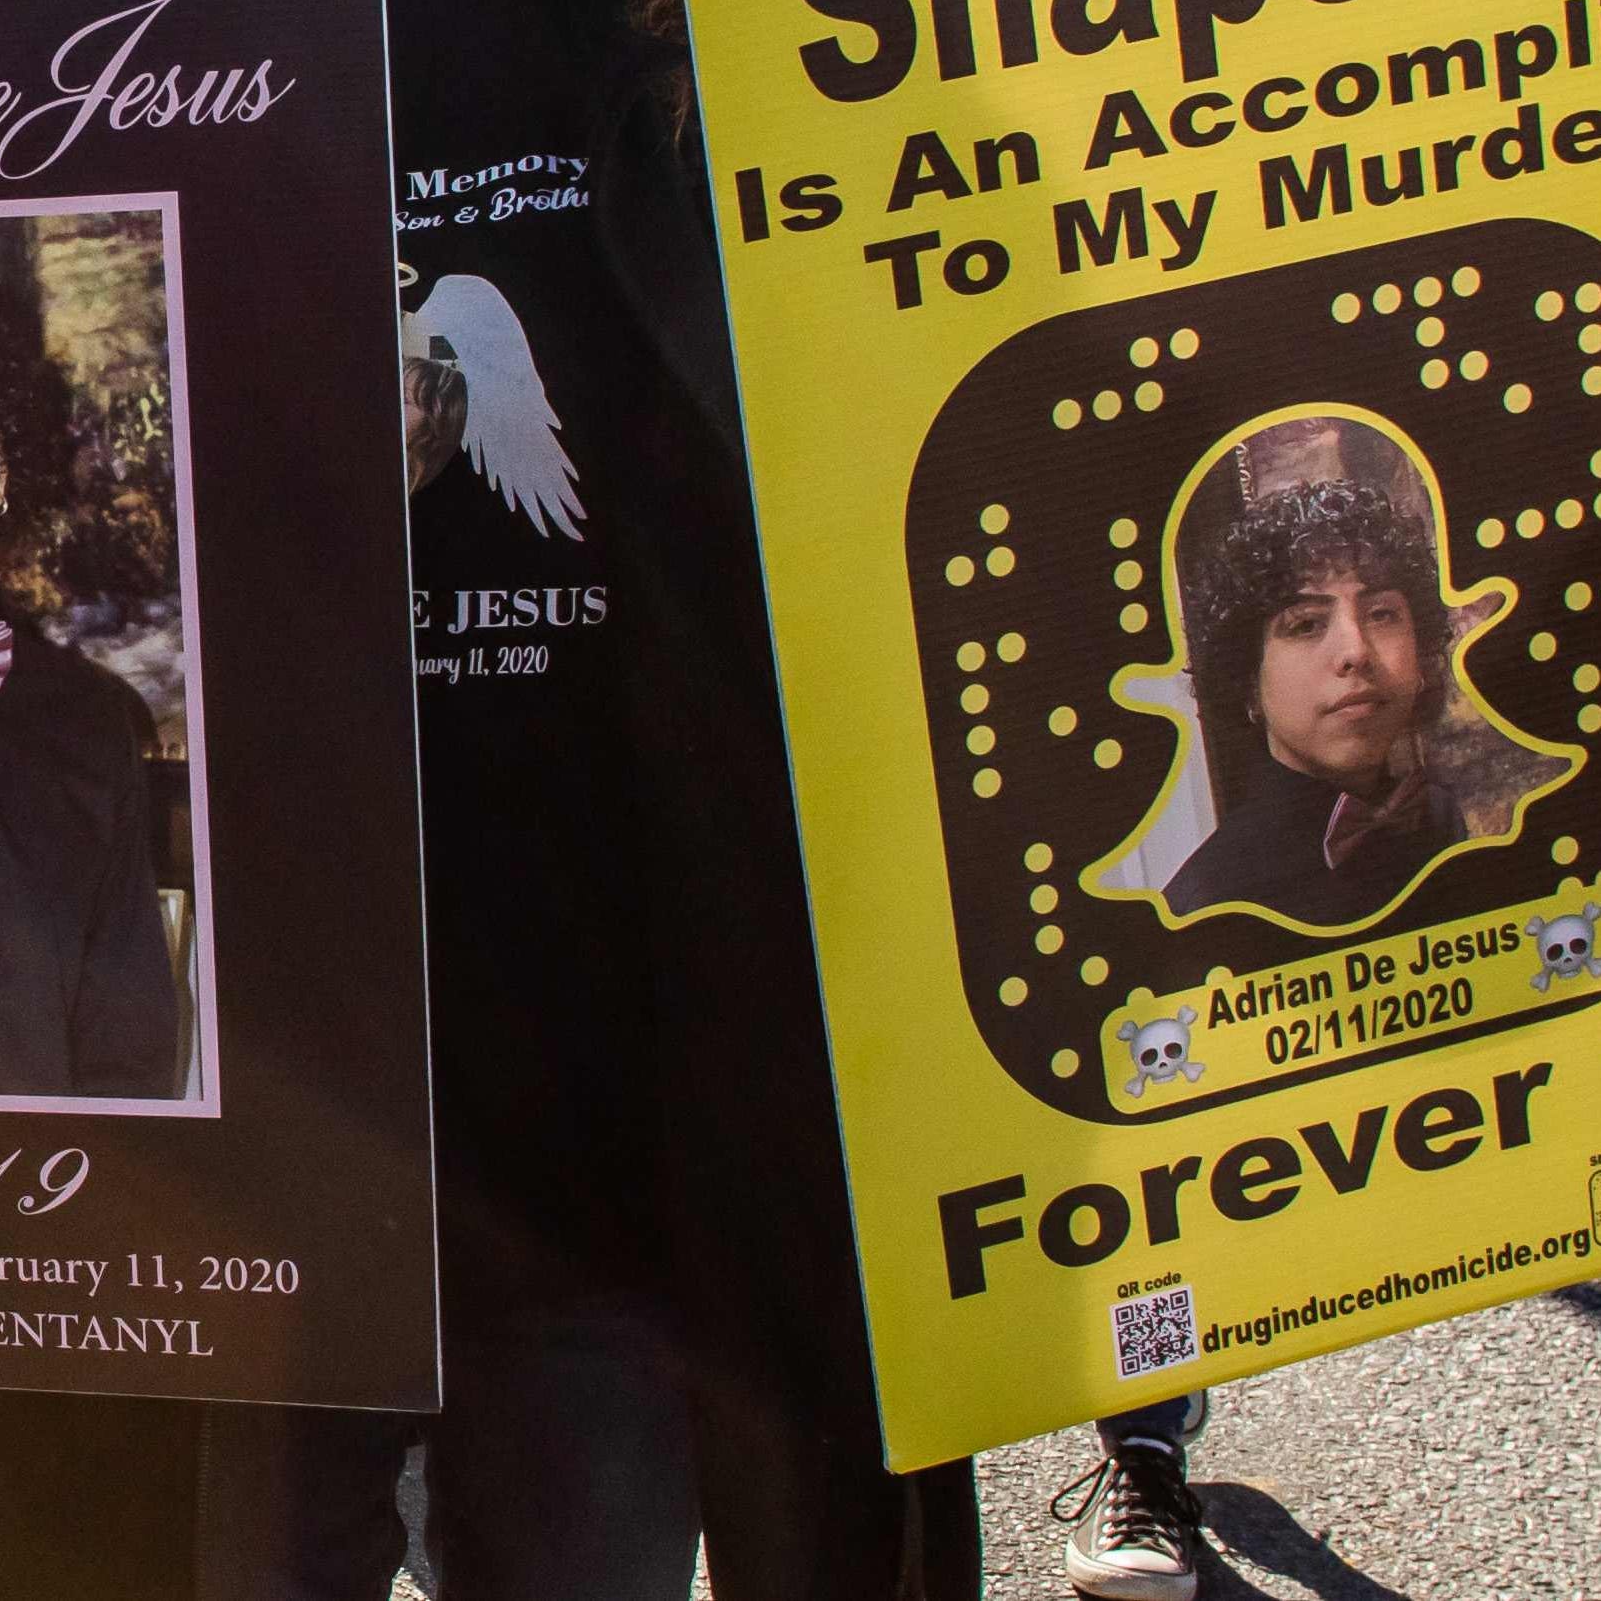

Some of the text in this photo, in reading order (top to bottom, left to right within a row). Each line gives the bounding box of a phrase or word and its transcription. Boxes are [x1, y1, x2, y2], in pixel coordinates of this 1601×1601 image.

[405, 154, 590, 201] Memory
[736, 165, 843, 243] Is
[886, 130, 1040, 213] An
[864, 103, 1601, 312] To My Murde
[453, 206, 479, 224] &
[447, 585, 607, 635] JESUS
[496, 645, 549, 674] 2020
[1206, 923, 1520, 1030] Adrian De Jesus
[1265, 977, 1473, 1066] 02/11/2020
[937, 1062, 1553, 1300] Forever
[126, 1253, 184, 1294] 11,
[199, 1256, 300, 1294] 2020
[1117, 1272, 1182, 1299] QR code
[1202, 1228, 1591, 1354] druginducedhomicide.org
